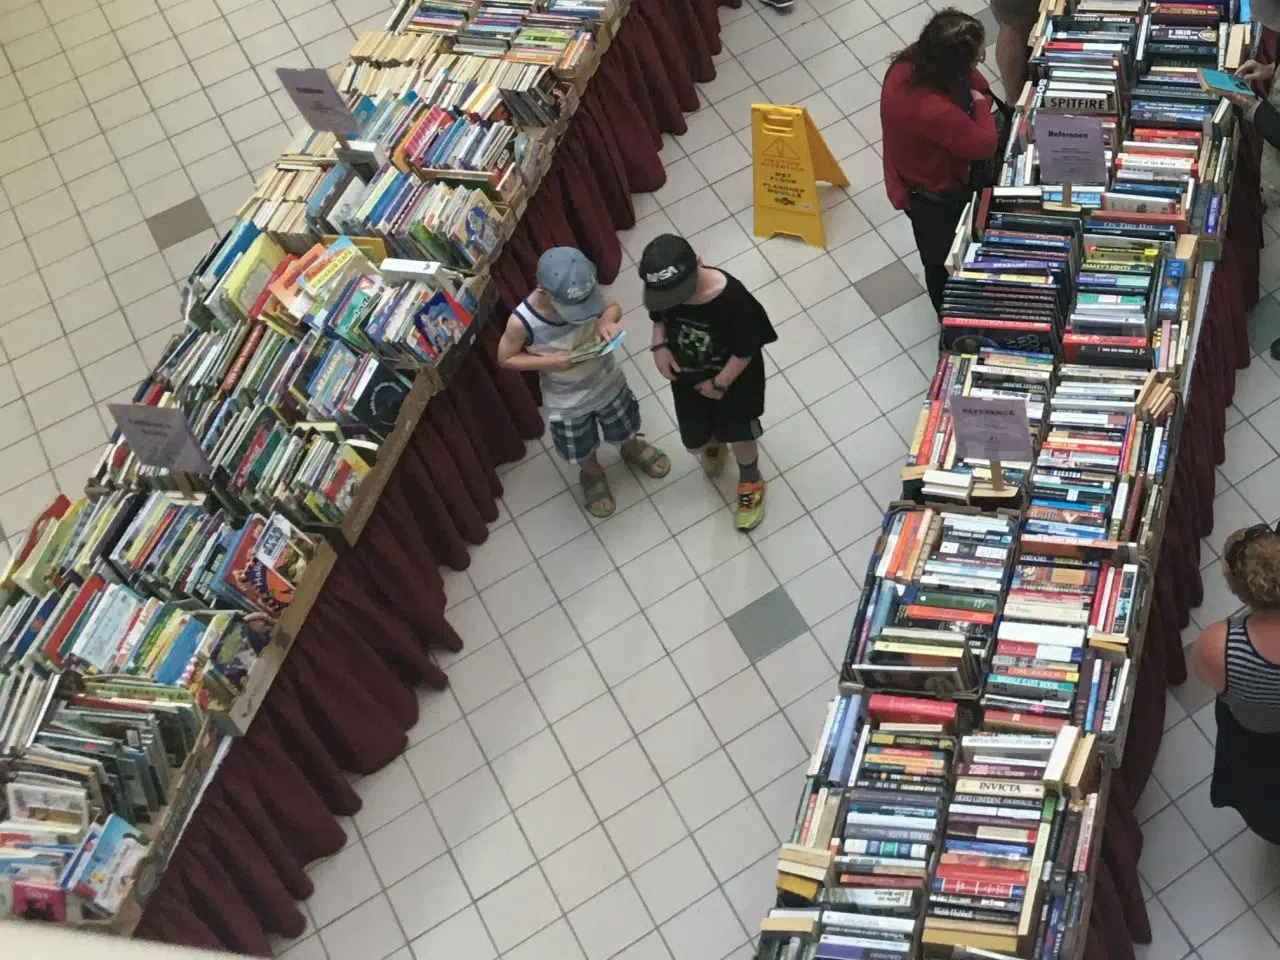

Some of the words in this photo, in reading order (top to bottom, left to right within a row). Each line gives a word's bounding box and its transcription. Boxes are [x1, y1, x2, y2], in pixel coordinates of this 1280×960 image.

[1050, 97, 1105, 109] SPITFIRE
[1048, 129, 1088, 139] Reference
[1124, 158, 1142, 166] History
[769, 175, 797, 185] FLOOR
[762, 182, 806, 194] PLANCHER
[979, 781, 1021, 792] INVICTA
